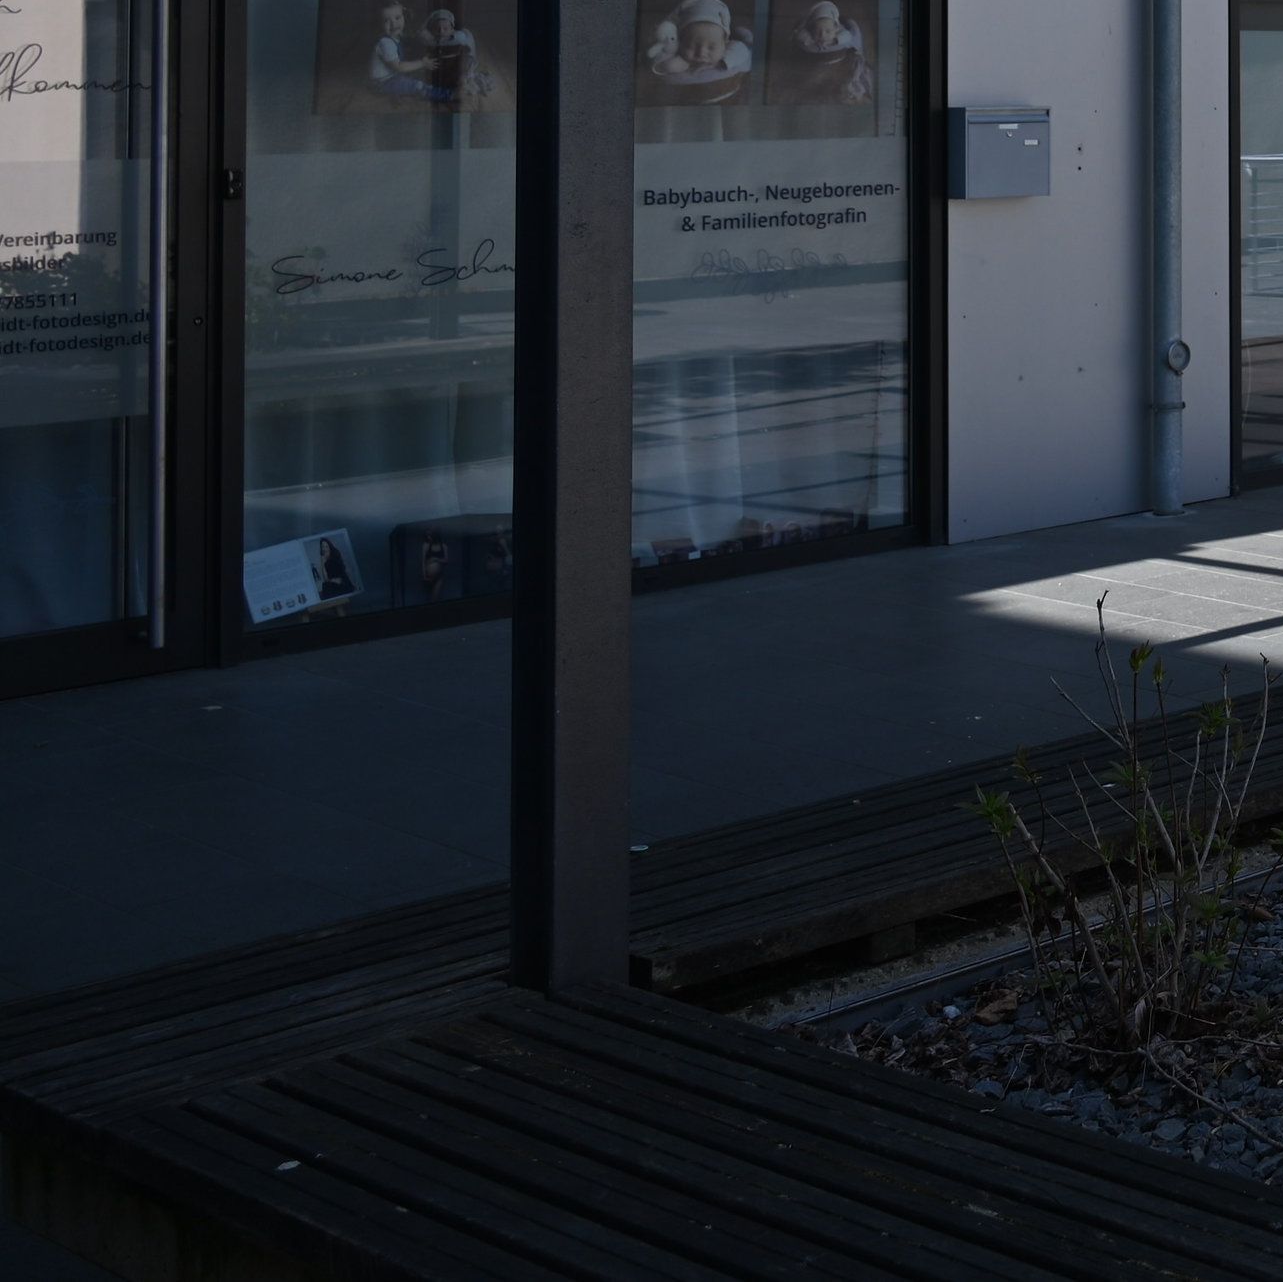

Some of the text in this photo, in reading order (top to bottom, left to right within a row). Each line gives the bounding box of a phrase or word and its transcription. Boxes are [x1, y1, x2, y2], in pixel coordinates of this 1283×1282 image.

[643, 181, 901, 206] Babybauch-, Neugeborenen-
[681, 206, 867, 232] & Familienfotografin
[0, 230, 118, 248] ereinbarung
[0, 254, 66, 273] sbilder
[271, 255, 403, 295] Simone
